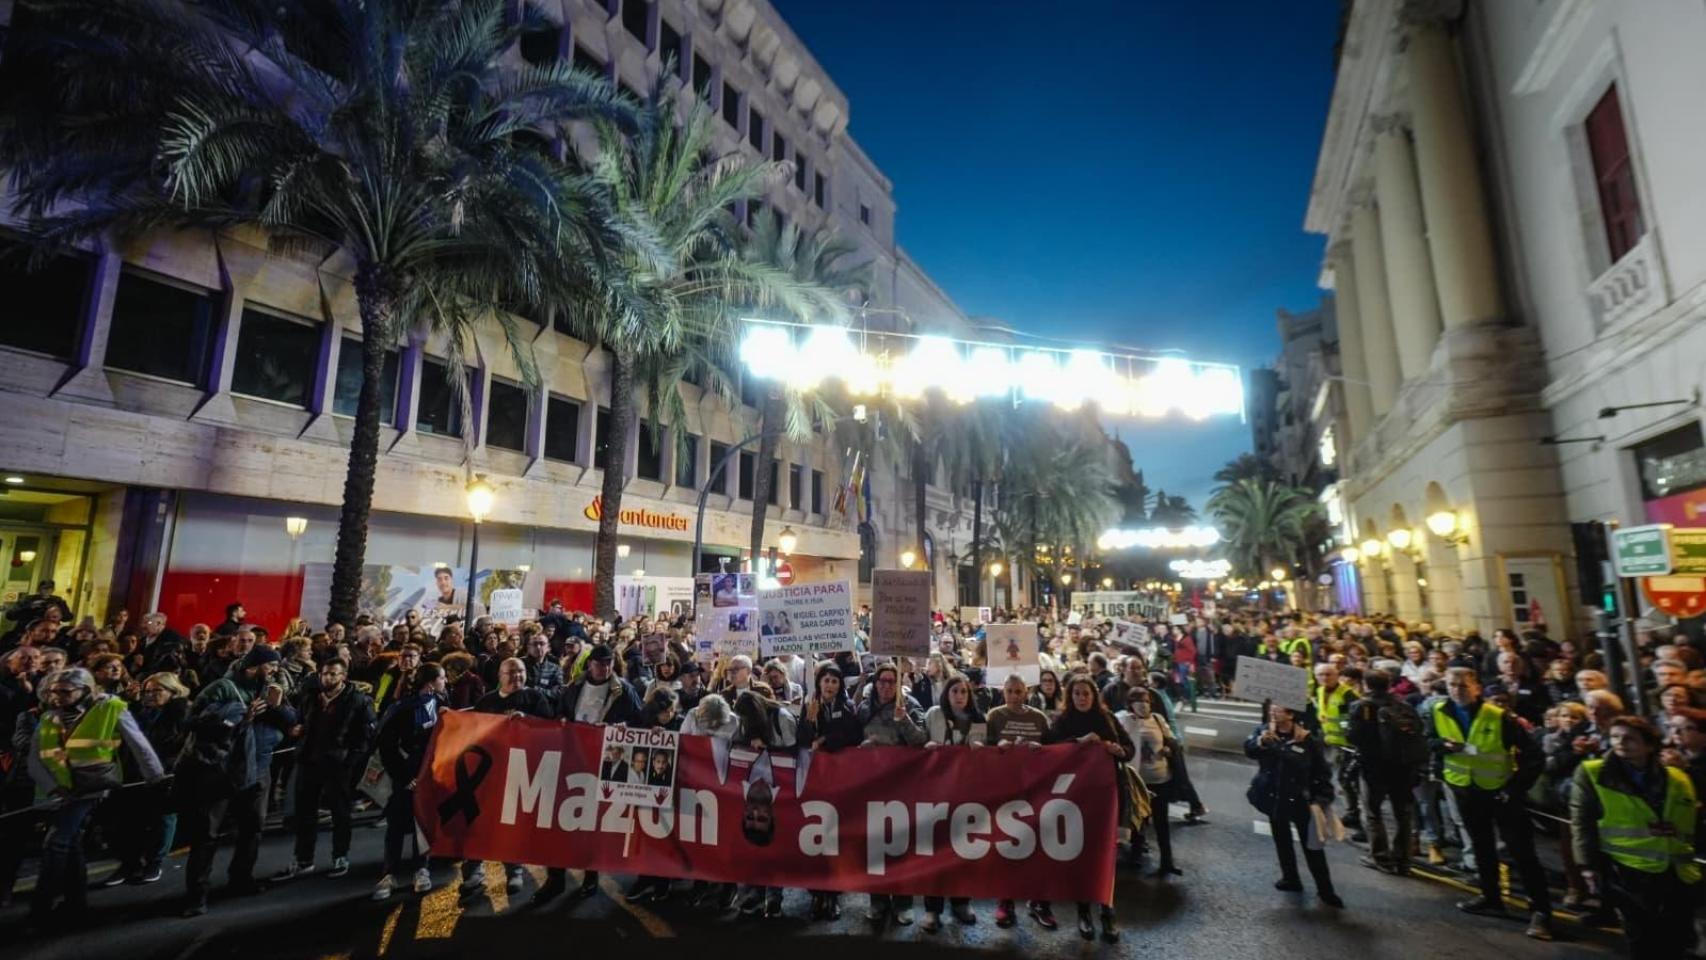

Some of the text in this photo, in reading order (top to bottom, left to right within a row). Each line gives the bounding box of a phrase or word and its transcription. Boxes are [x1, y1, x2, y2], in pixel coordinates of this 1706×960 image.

[617, 508, 688, 531] antander
[813, 583, 844, 595] PARA
[793, 610, 818, 619] MIGUEL
[818, 608, 844, 617] CARPIO
[800, 618, 845, 628] SARA CARPIO
[774, 635, 797, 643] TODAS
[606, 729, 676, 747] JUSTICIA
[799, 800, 839, 856] a
[867, 773, 1084, 876] presó
